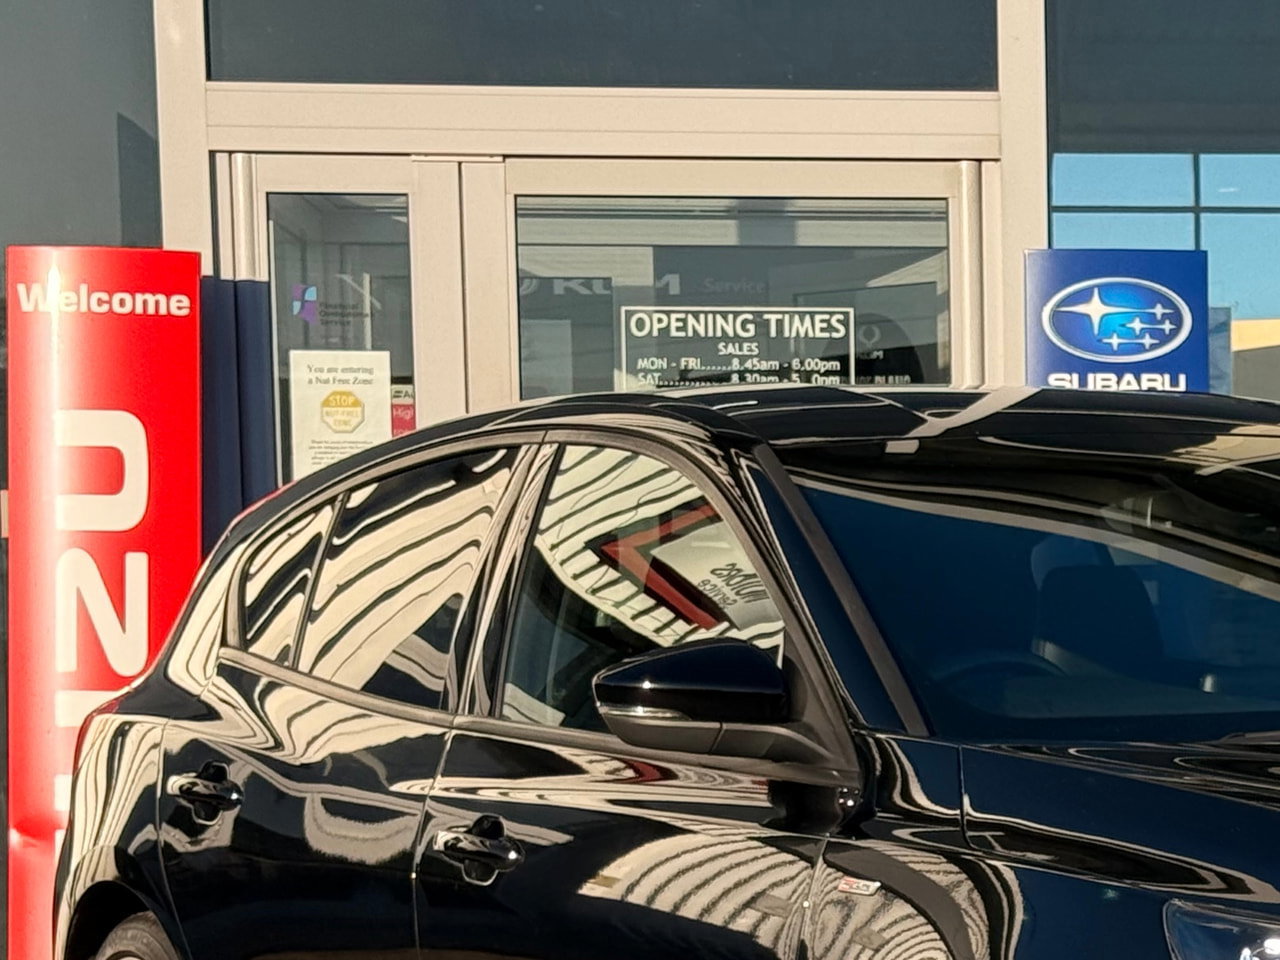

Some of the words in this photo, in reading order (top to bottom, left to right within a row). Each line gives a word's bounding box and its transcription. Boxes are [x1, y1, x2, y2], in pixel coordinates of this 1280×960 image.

[16, 283, 191, 317] Welcome
[629, 312, 756, 338] OPENING
[762, 312, 847, 339] TIMES
[717, 341, 760, 355] SALES
[307, 364, 325, 374] You
[340, 365, 375, 376] entering
[636, 357, 668, 370] MON
[791, 357, 841, 374] 6.00pm
[332, 376, 351, 385] Free
[352, 376, 374, 385] Zone
[1046, 372, 1187, 393] SUBARU
[328, 395, 356, 407] STOP
